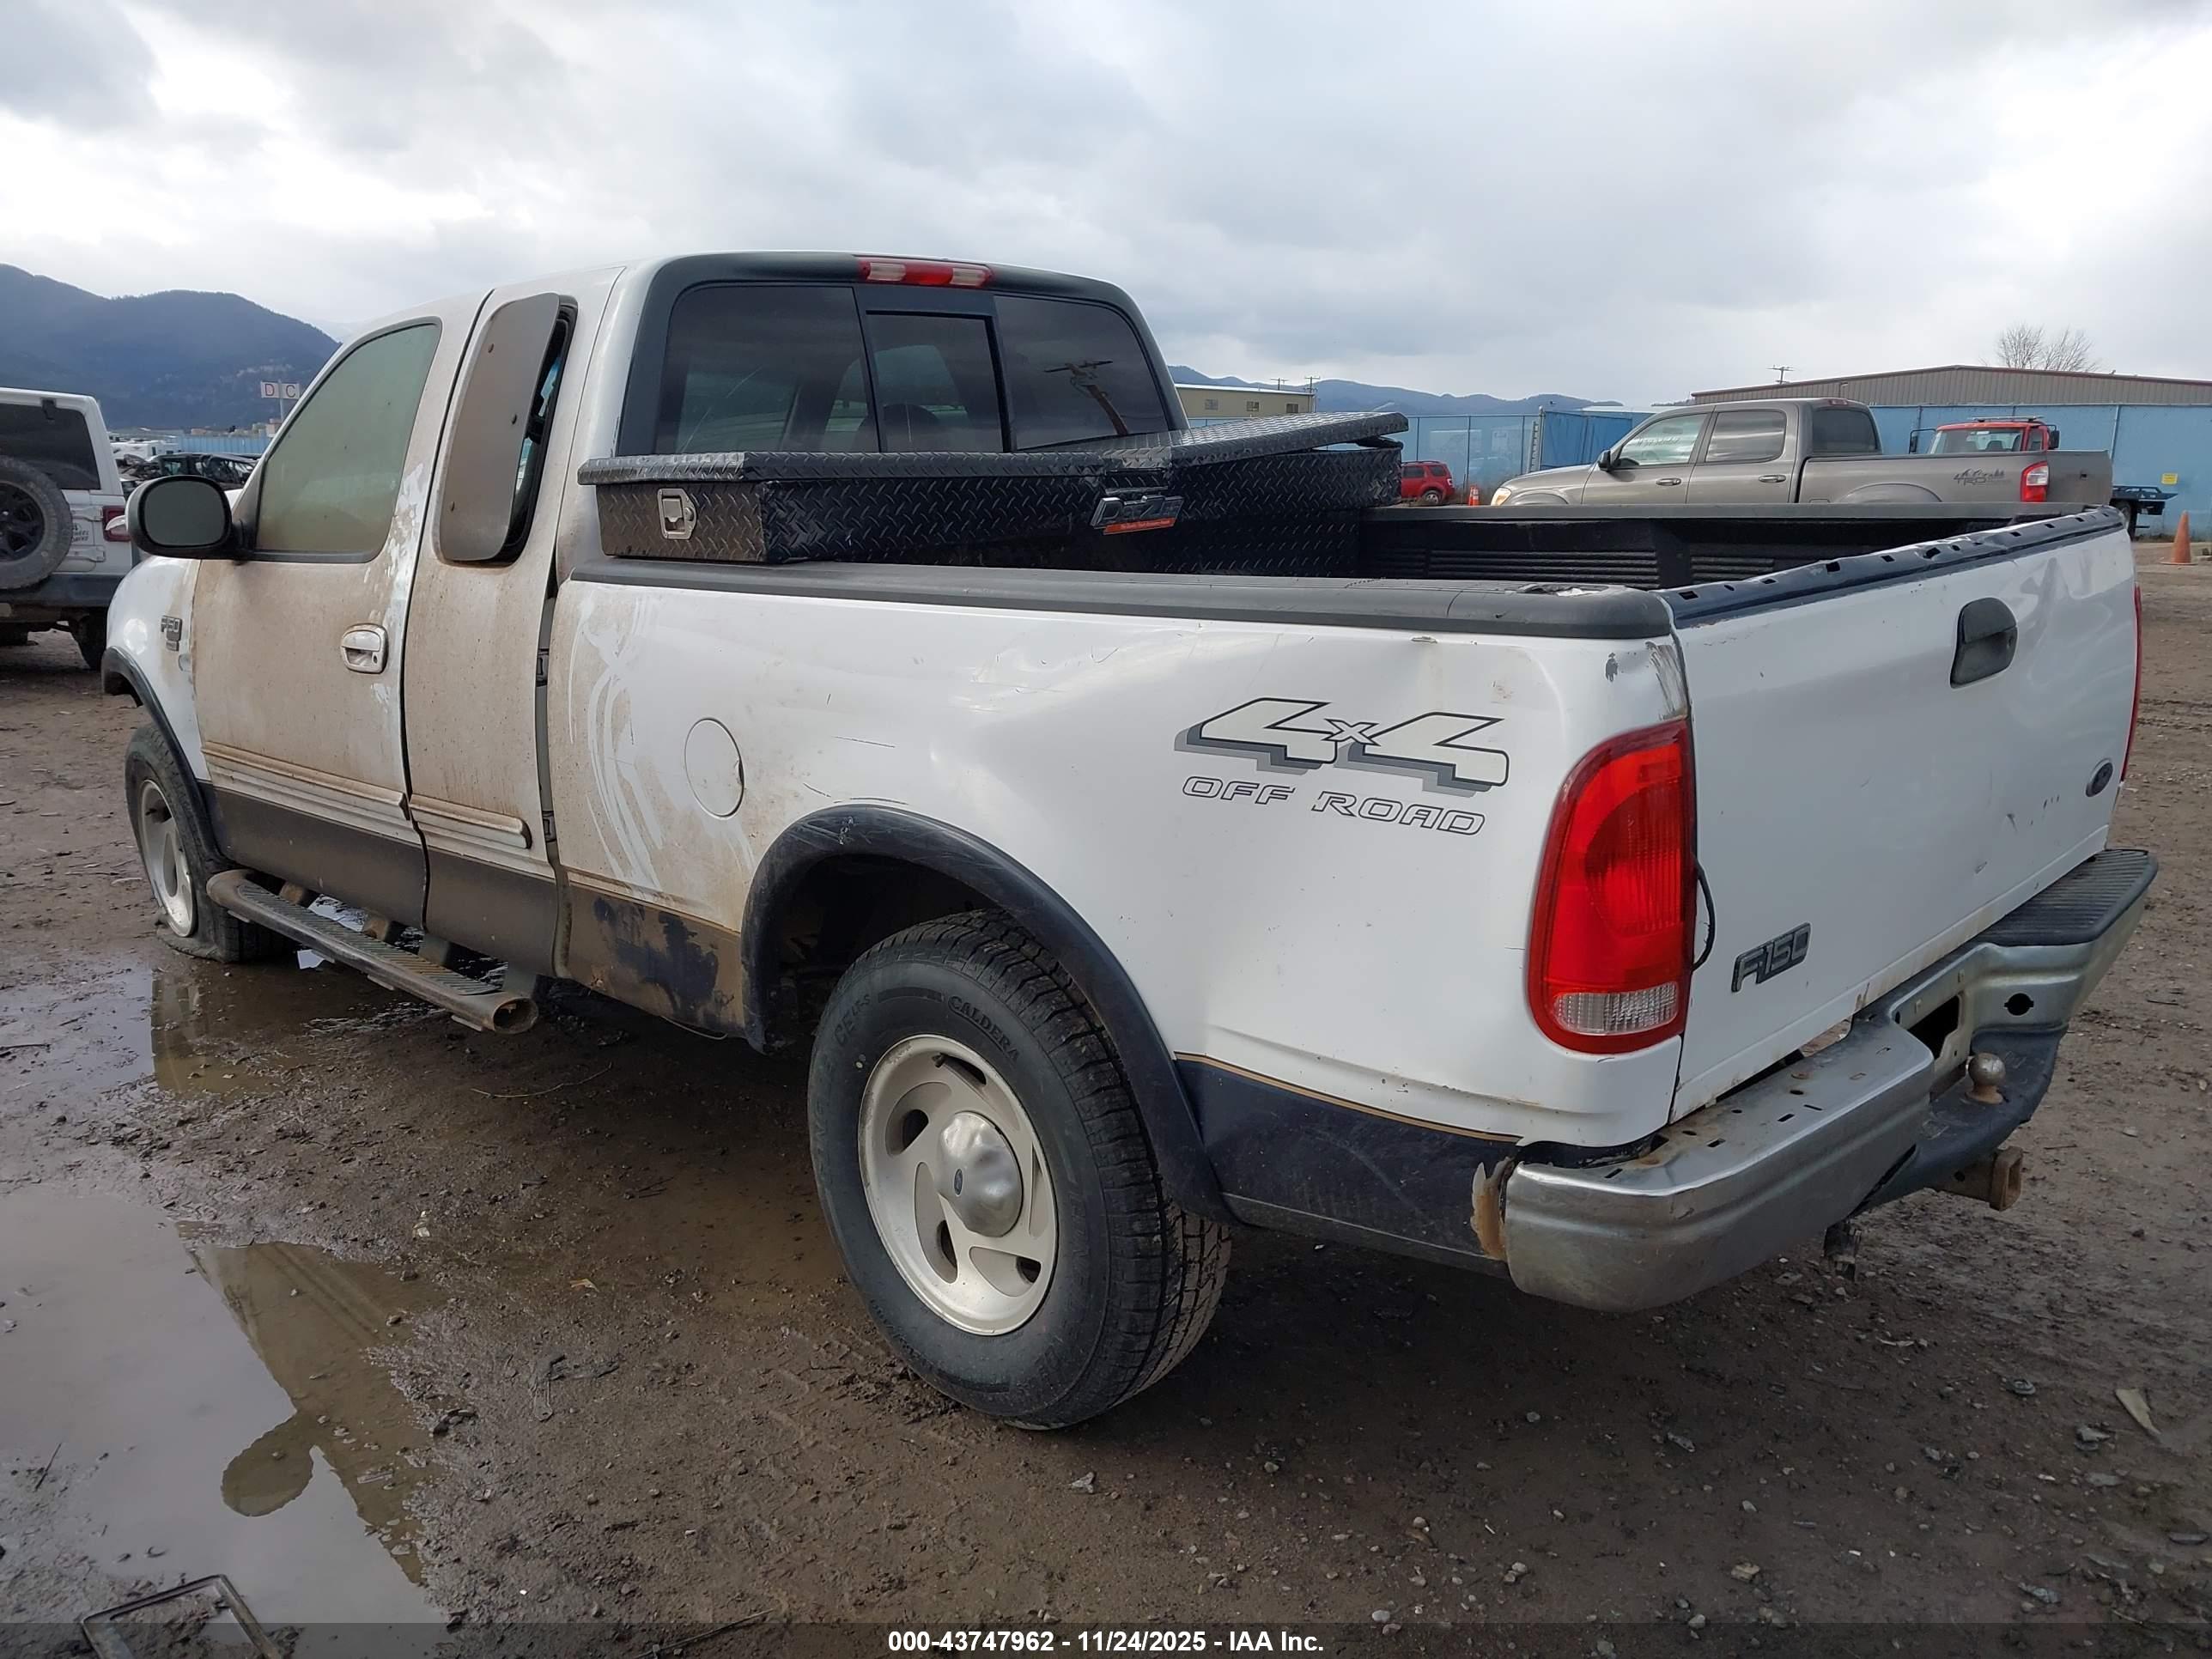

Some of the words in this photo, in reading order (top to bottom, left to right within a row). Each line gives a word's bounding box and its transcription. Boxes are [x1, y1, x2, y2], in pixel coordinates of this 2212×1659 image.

[1182, 775, 1296, 805] OFF
[1310, 790, 1486, 836] ROAD
[946, 994, 1021, 1061] CALDERA
